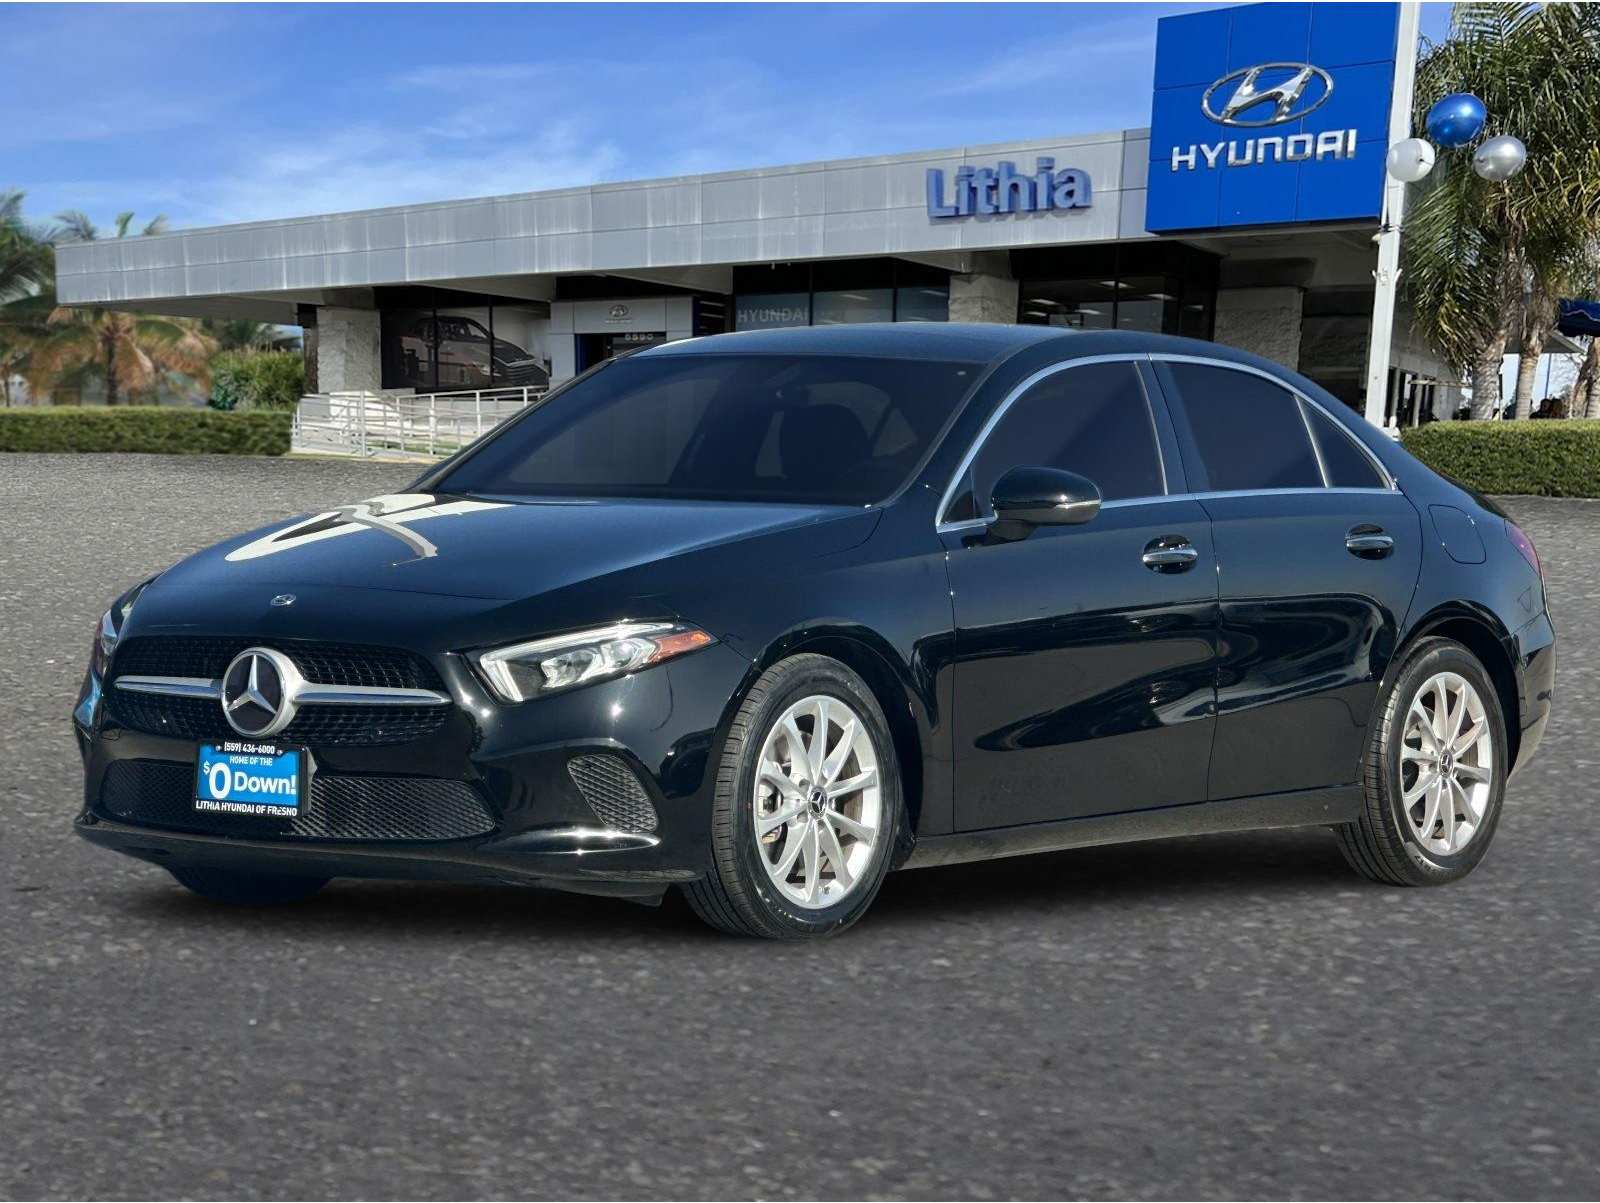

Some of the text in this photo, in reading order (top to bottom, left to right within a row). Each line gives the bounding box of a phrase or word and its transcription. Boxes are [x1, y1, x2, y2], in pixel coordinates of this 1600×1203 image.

[1171, 129, 1357, 172] HYUNDAI
[926, 157, 1093, 220] Lithia
[737, 307, 809, 323] HYUNDAI
[242, 743, 275, 754] 436-6000
[229, 756, 273, 766] HOME OF THE
[234, 771, 297, 795] Down!
[195, 800, 298, 817] LITHIA HYUNDAI OF FRESNO
